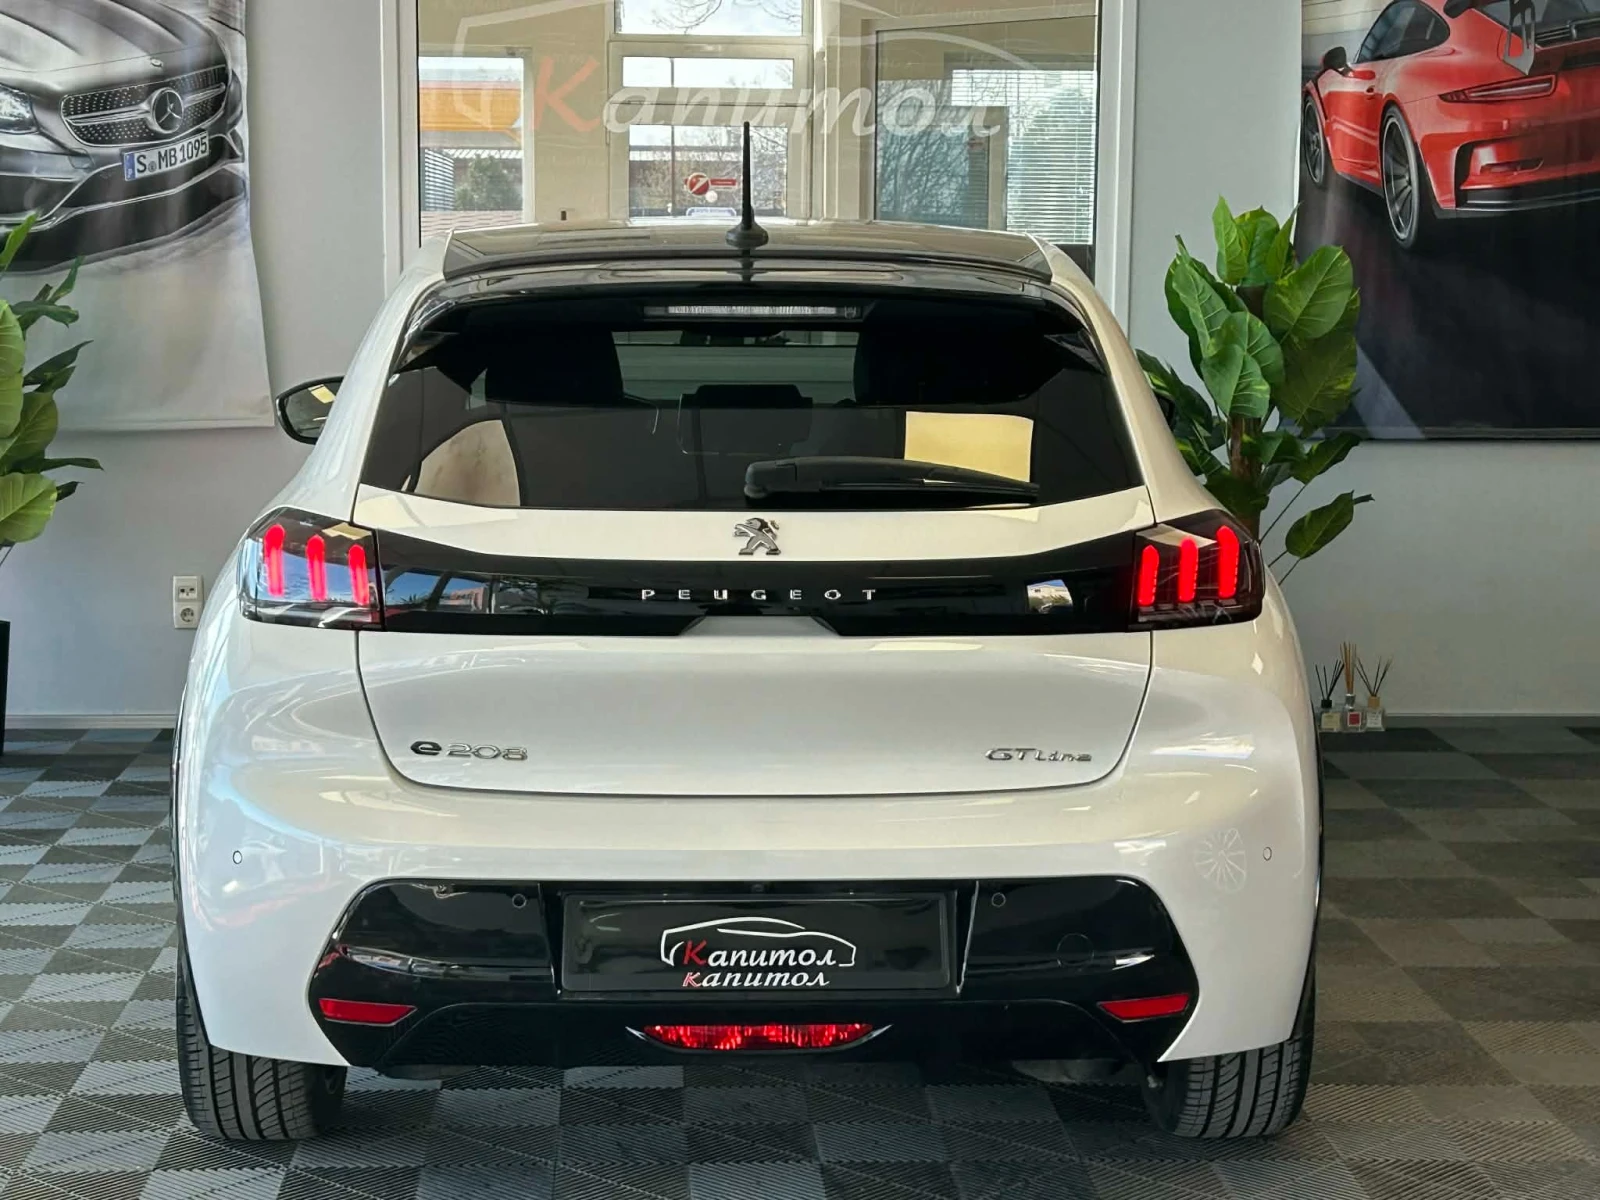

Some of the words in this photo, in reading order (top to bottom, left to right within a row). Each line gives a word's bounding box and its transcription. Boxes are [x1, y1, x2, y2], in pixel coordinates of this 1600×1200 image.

[137, 155, 148, 173] S
[641, 589, 876, 600] PEUGEOT
[683, 939, 836, 966] Капитол
